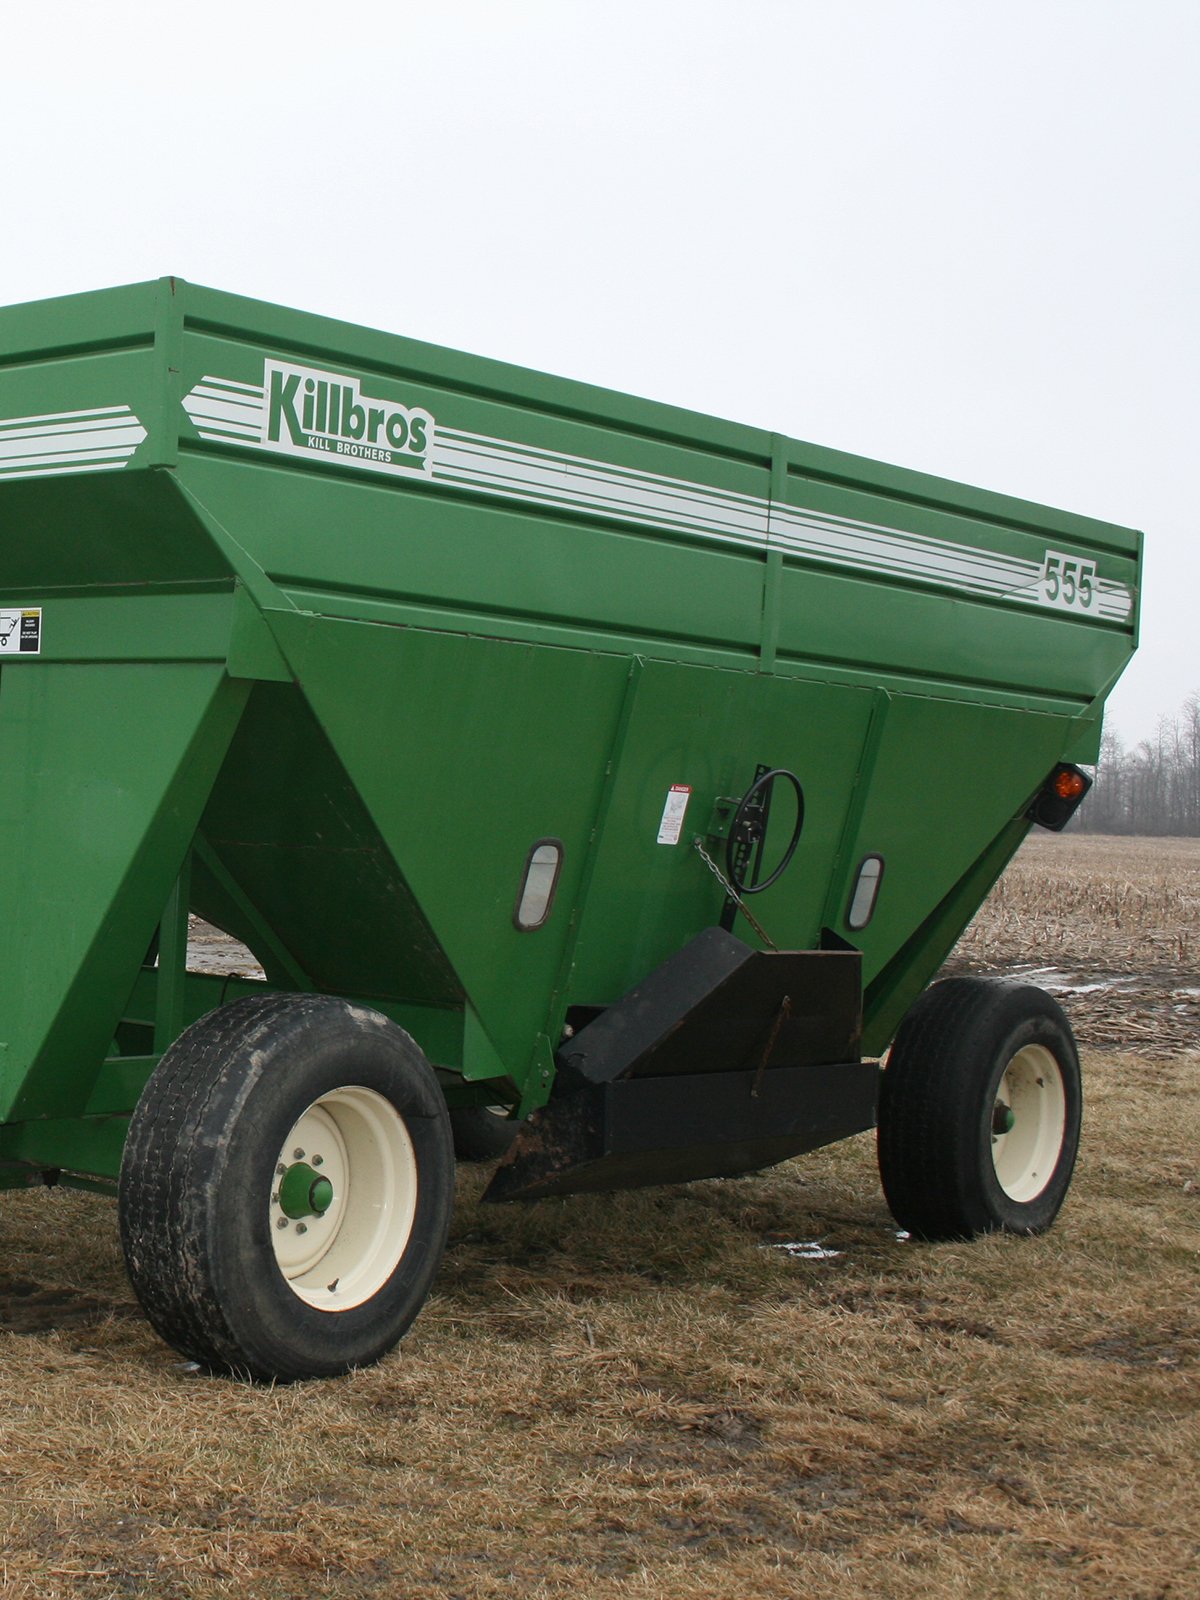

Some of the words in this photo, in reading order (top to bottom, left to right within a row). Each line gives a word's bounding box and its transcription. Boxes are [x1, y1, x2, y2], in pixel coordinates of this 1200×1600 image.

[267, 369, 428, 453] Killbros
[307, 435, 331, 451] KILL
[336, 441, 392, 463] BROTHERS
[1045, 556, 1093, 609] 555
